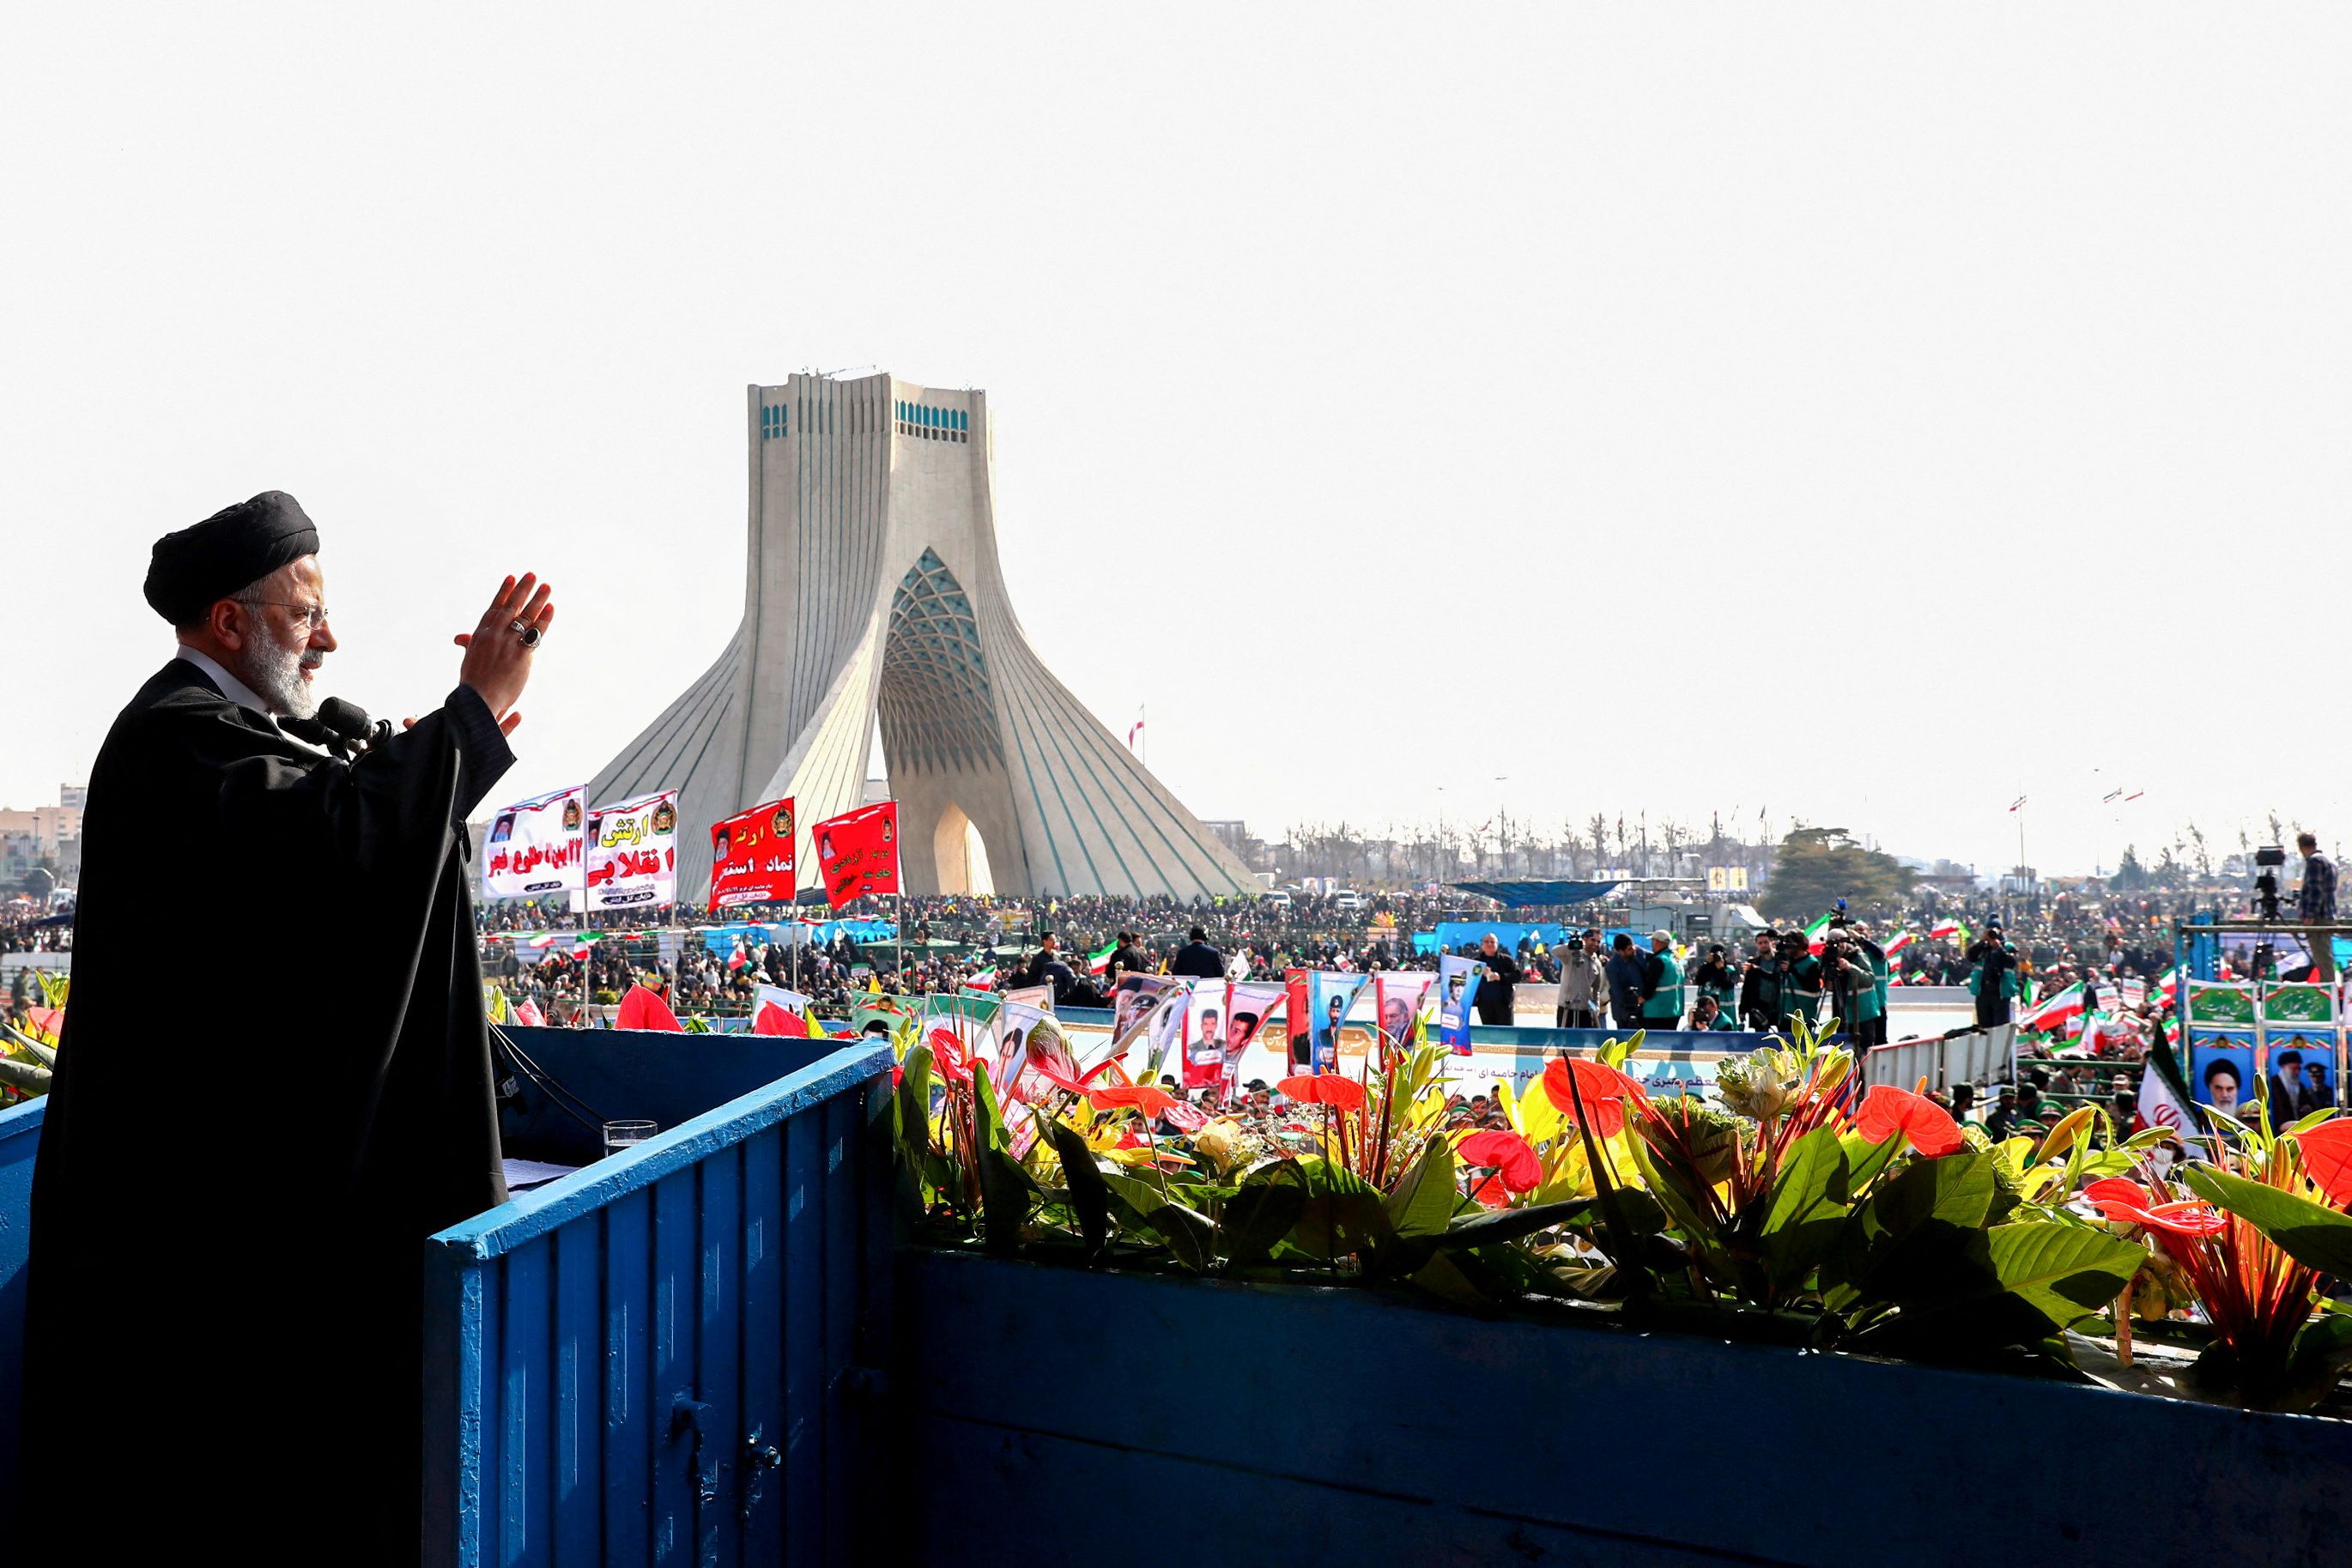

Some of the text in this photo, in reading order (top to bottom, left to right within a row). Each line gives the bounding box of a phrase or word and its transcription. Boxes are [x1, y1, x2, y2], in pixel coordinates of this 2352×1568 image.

[601, 814, 649, 848] ارتش
[488, 846, 508, 878] فجر
[512, 845, 543, 875] طلوع
[587, 845, 674, 887] انقلابی
[766, 854, 793, 872] نماد
[1478, 1068, 1488, 1079] ای
[1652, 1075, 1683, 1089] هبری
